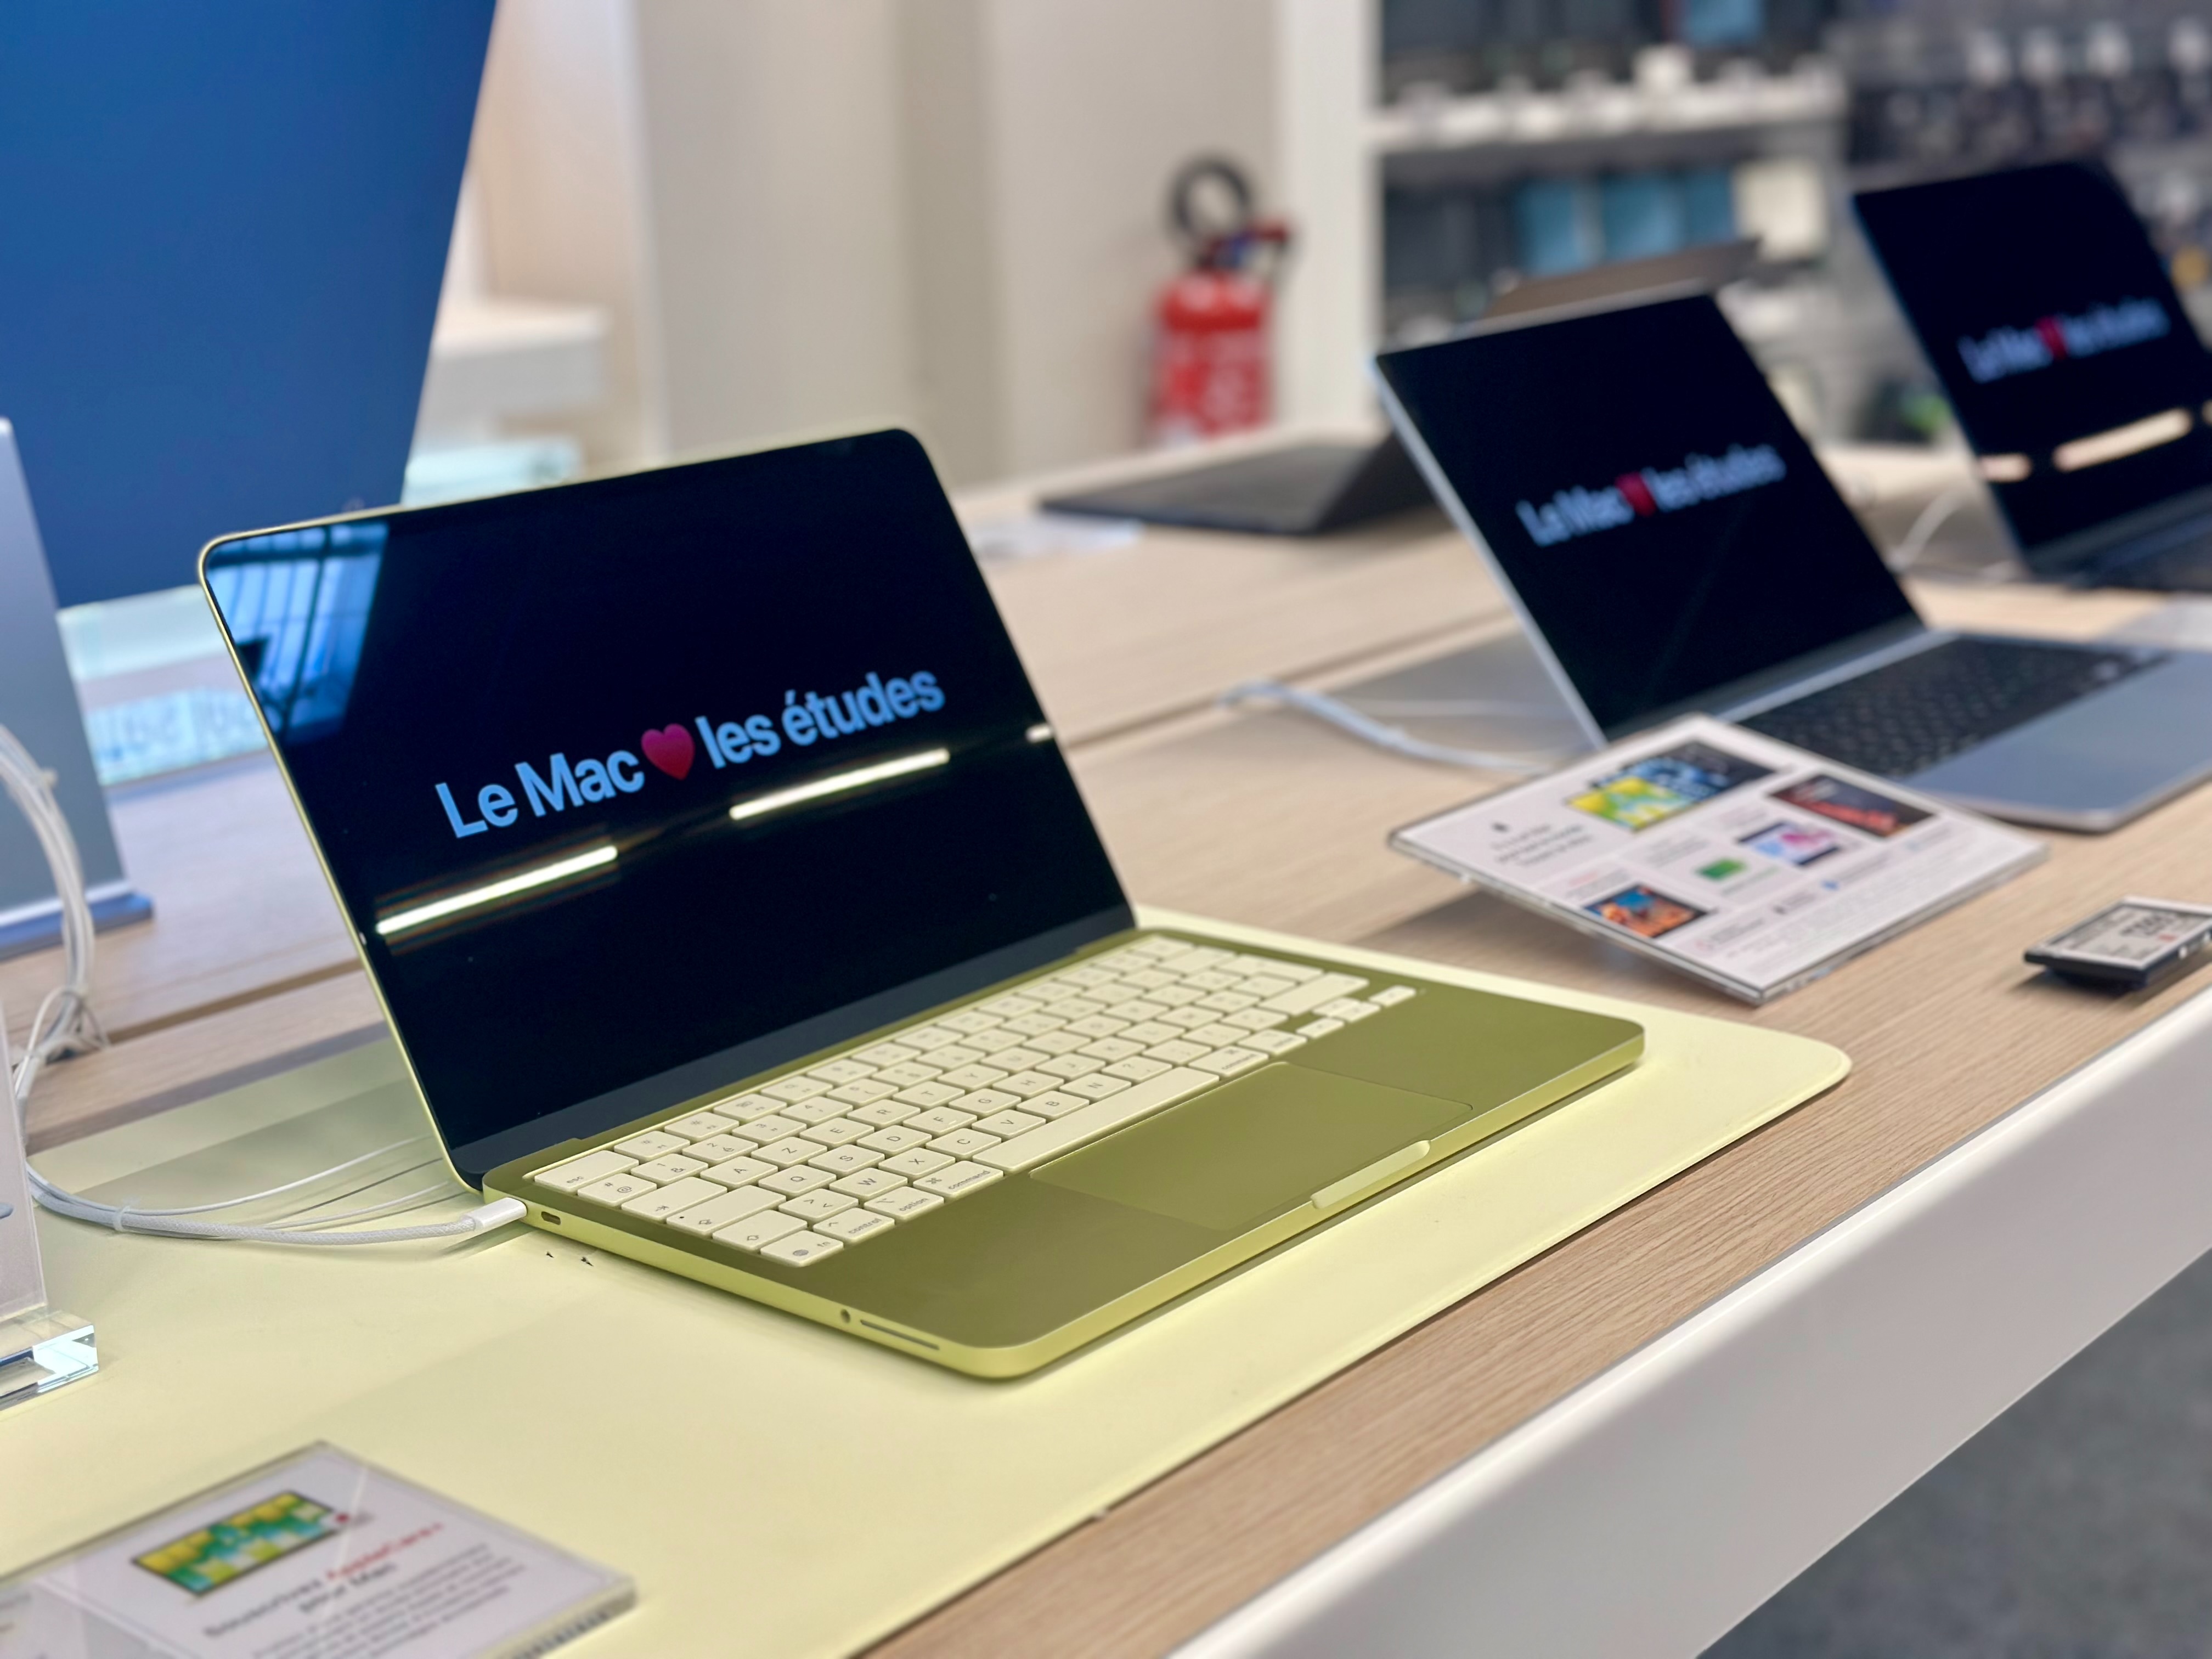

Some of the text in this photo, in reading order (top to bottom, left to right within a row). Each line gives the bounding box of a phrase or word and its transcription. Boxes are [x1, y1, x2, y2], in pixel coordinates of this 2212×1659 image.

[436, 670, 945, 838] Le Mac les études
[948, 1170, 990, 1189] command
[899, 1197, 929, 1211] option
[848, 1218, 882, 1233] control
